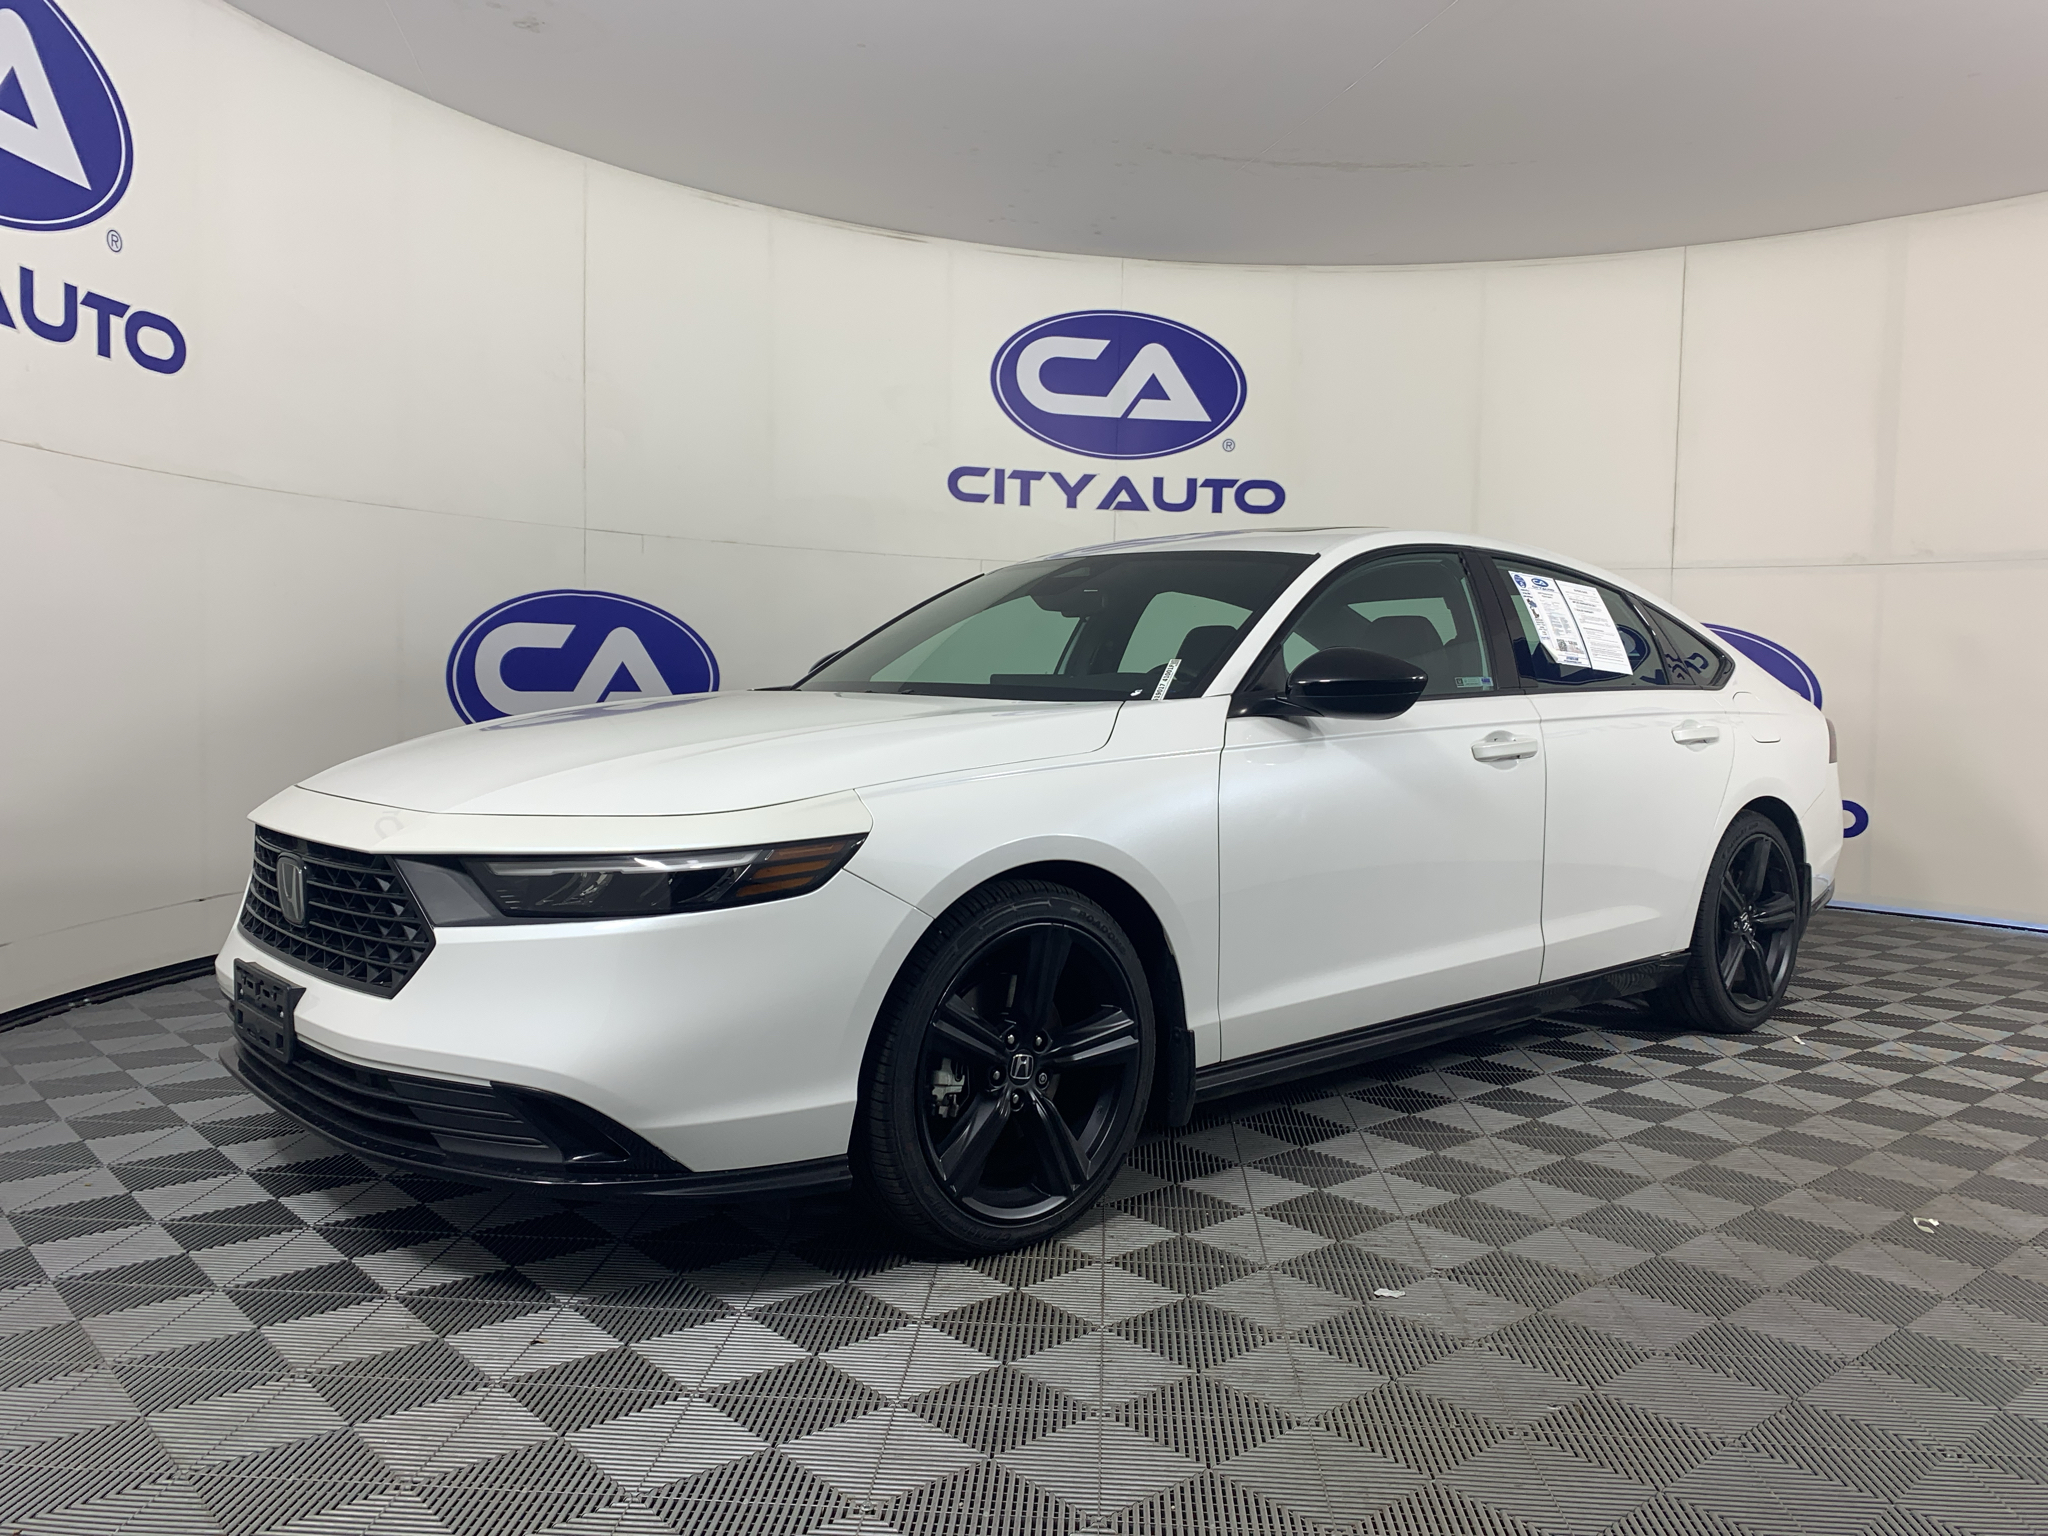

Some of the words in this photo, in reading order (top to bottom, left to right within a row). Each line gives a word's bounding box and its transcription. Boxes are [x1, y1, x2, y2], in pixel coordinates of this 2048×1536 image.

[0, 265, 187, 375] UTO
[1016, 336, 1212, 423] CA
[947, 466, 1099, 510] CITY
[1096, 475, 1286, 515] AUTO
[475, 622, 673, 717] CA
